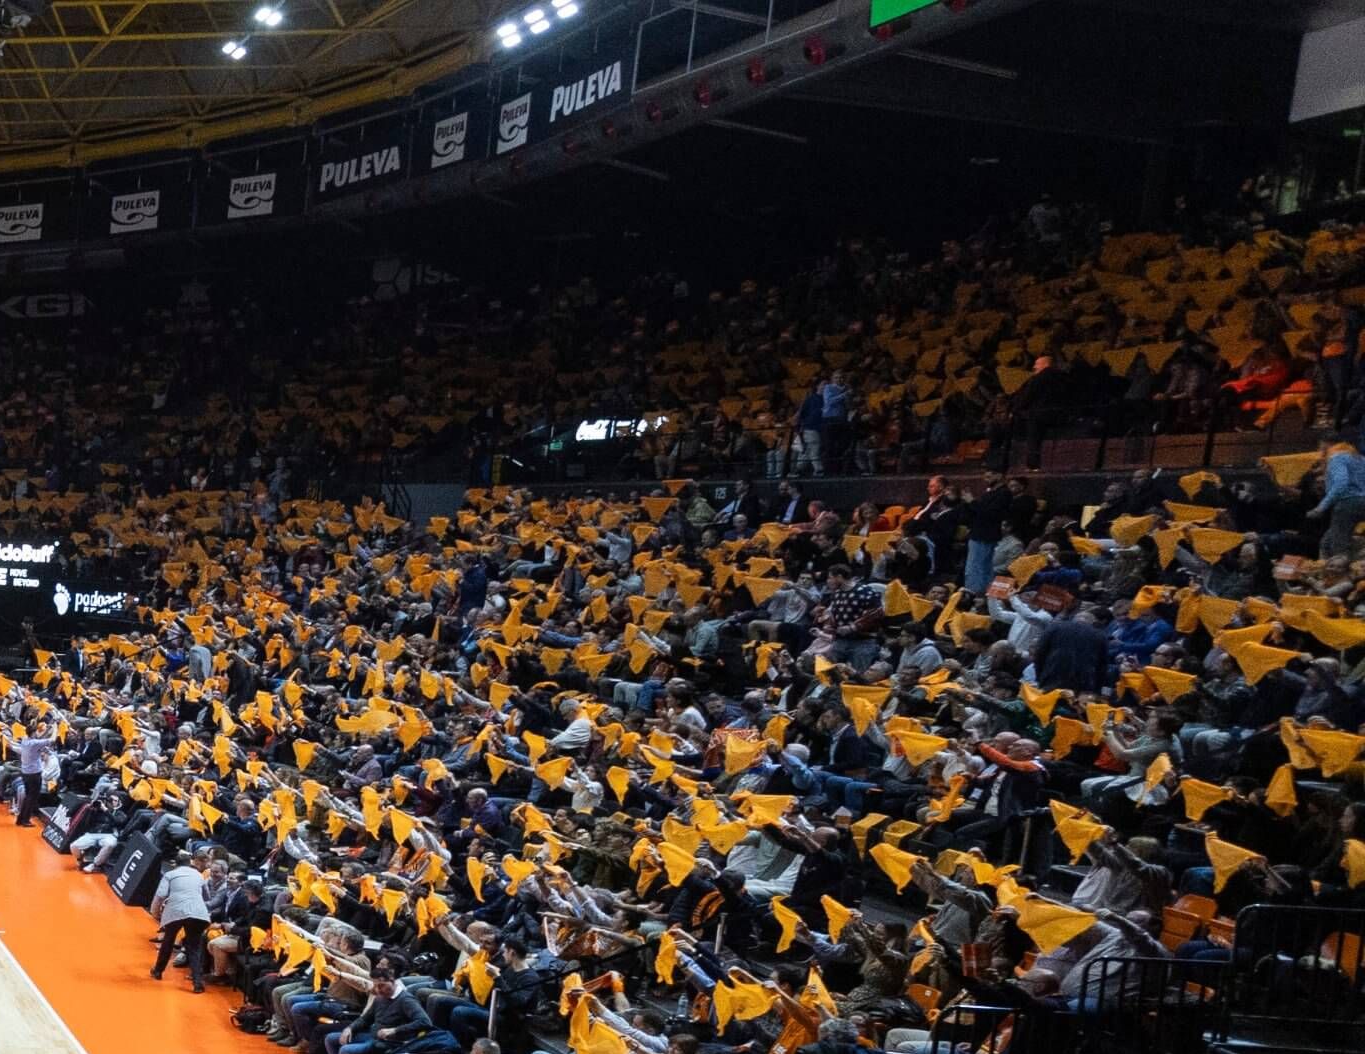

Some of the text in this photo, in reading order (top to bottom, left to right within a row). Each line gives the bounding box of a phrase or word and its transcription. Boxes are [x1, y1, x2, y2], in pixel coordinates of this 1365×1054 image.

[550, 61, 621, 122] PULEVA
[500, 101, 529, 127] PULEVA
[319, 145, 400, 192] PULEVA
[232, 181, 273, 195] PULEVA
[114, 194, 158, 213] PULEVA
